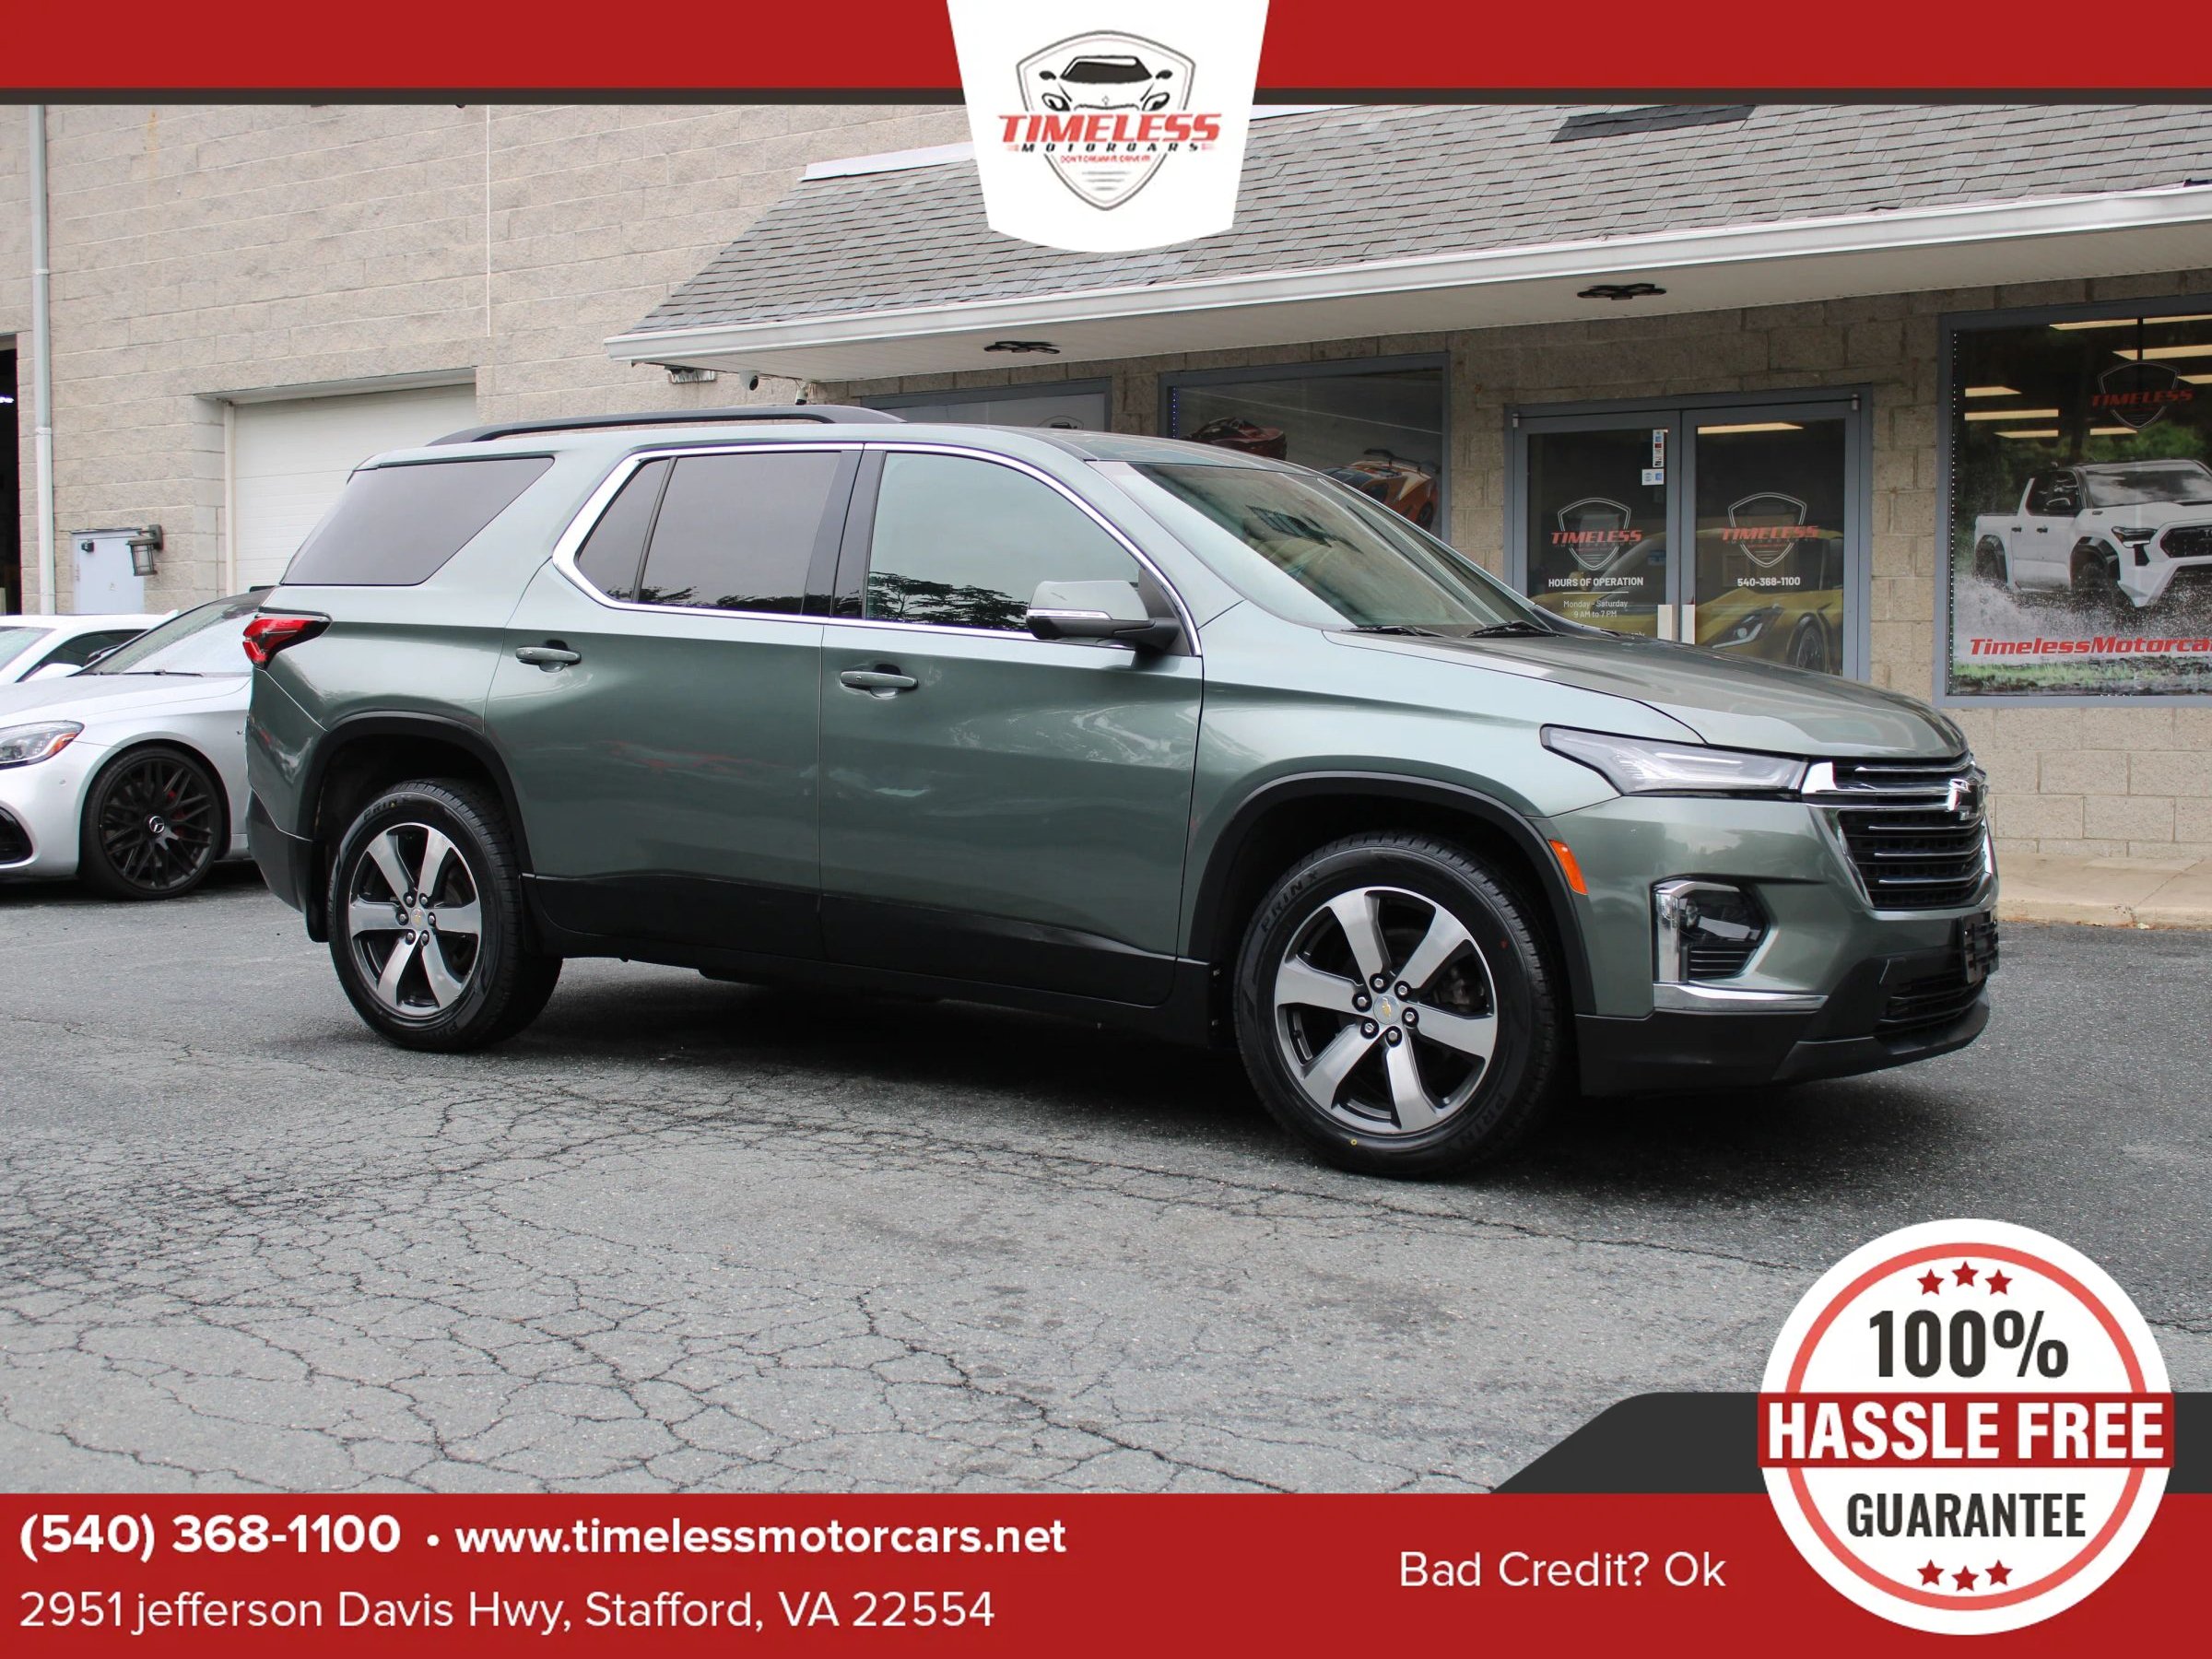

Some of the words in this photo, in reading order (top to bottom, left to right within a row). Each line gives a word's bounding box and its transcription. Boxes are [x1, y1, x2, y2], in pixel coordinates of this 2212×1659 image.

[2092, 389, 2194, 407] TIMELESS
[1551, 529, 1643, 545] TIMELESS
[1722, 525, 1819, 541] TIMELESS
[1548, 578, 1578, 587] HOURS
[1580, 578, 1591, 587] OF
[1593, 577, 1644, 587] OPERATION
[1736, 576, 1801, 587] 540-368-1100
[1563, 600, 1591, 610] Monday
[1595, 599, 1629, 609] Saturday
[1580, 610, 1591, 618] AM
[1592, 610, 1600, 618] to
[1971, 636, 2212, 656] TimelessMotorca
